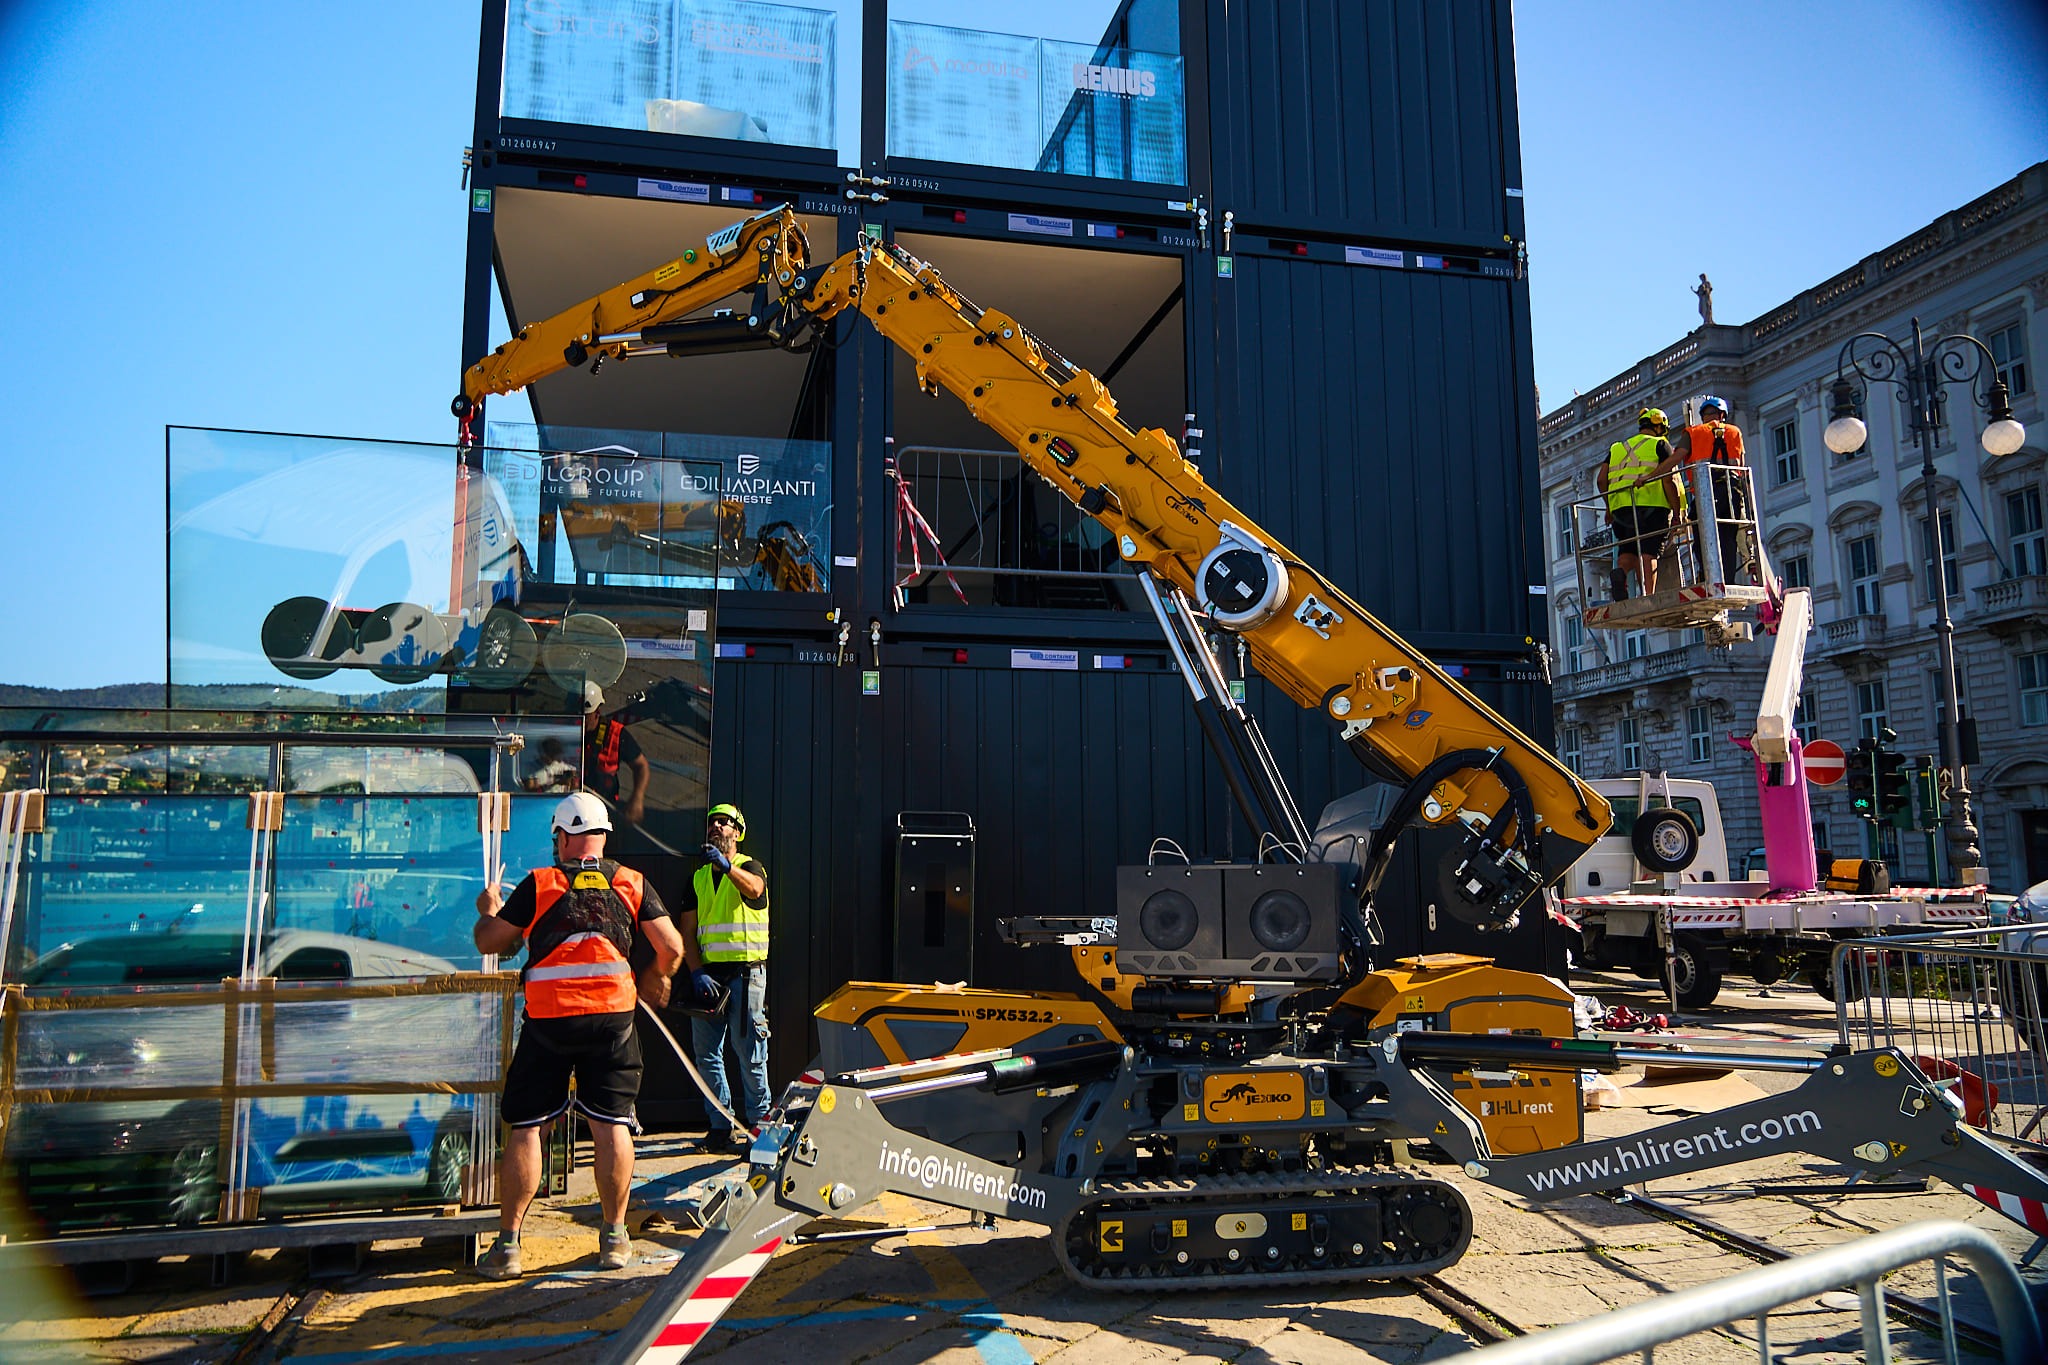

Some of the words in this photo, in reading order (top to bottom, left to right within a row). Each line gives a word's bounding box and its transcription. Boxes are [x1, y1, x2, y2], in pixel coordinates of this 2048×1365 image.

[1073, 63, 1156, 97] GENIUS
[503, 463, 644, 487] EDILGROUP
[680, 475, 816, 497] EDILIMPIANTI
[599, 488, 644, 499] FUTURE
[724, 494, 773, 505] TRIESTE
[826, 652, 855, 662] 0638
[975, 1008, 1053, 1023] SPX532.2
[1527, 1109, 1823, 1192] www.hlirent.com
[878, 1139, 1047, 1209] info@hlirent.com
